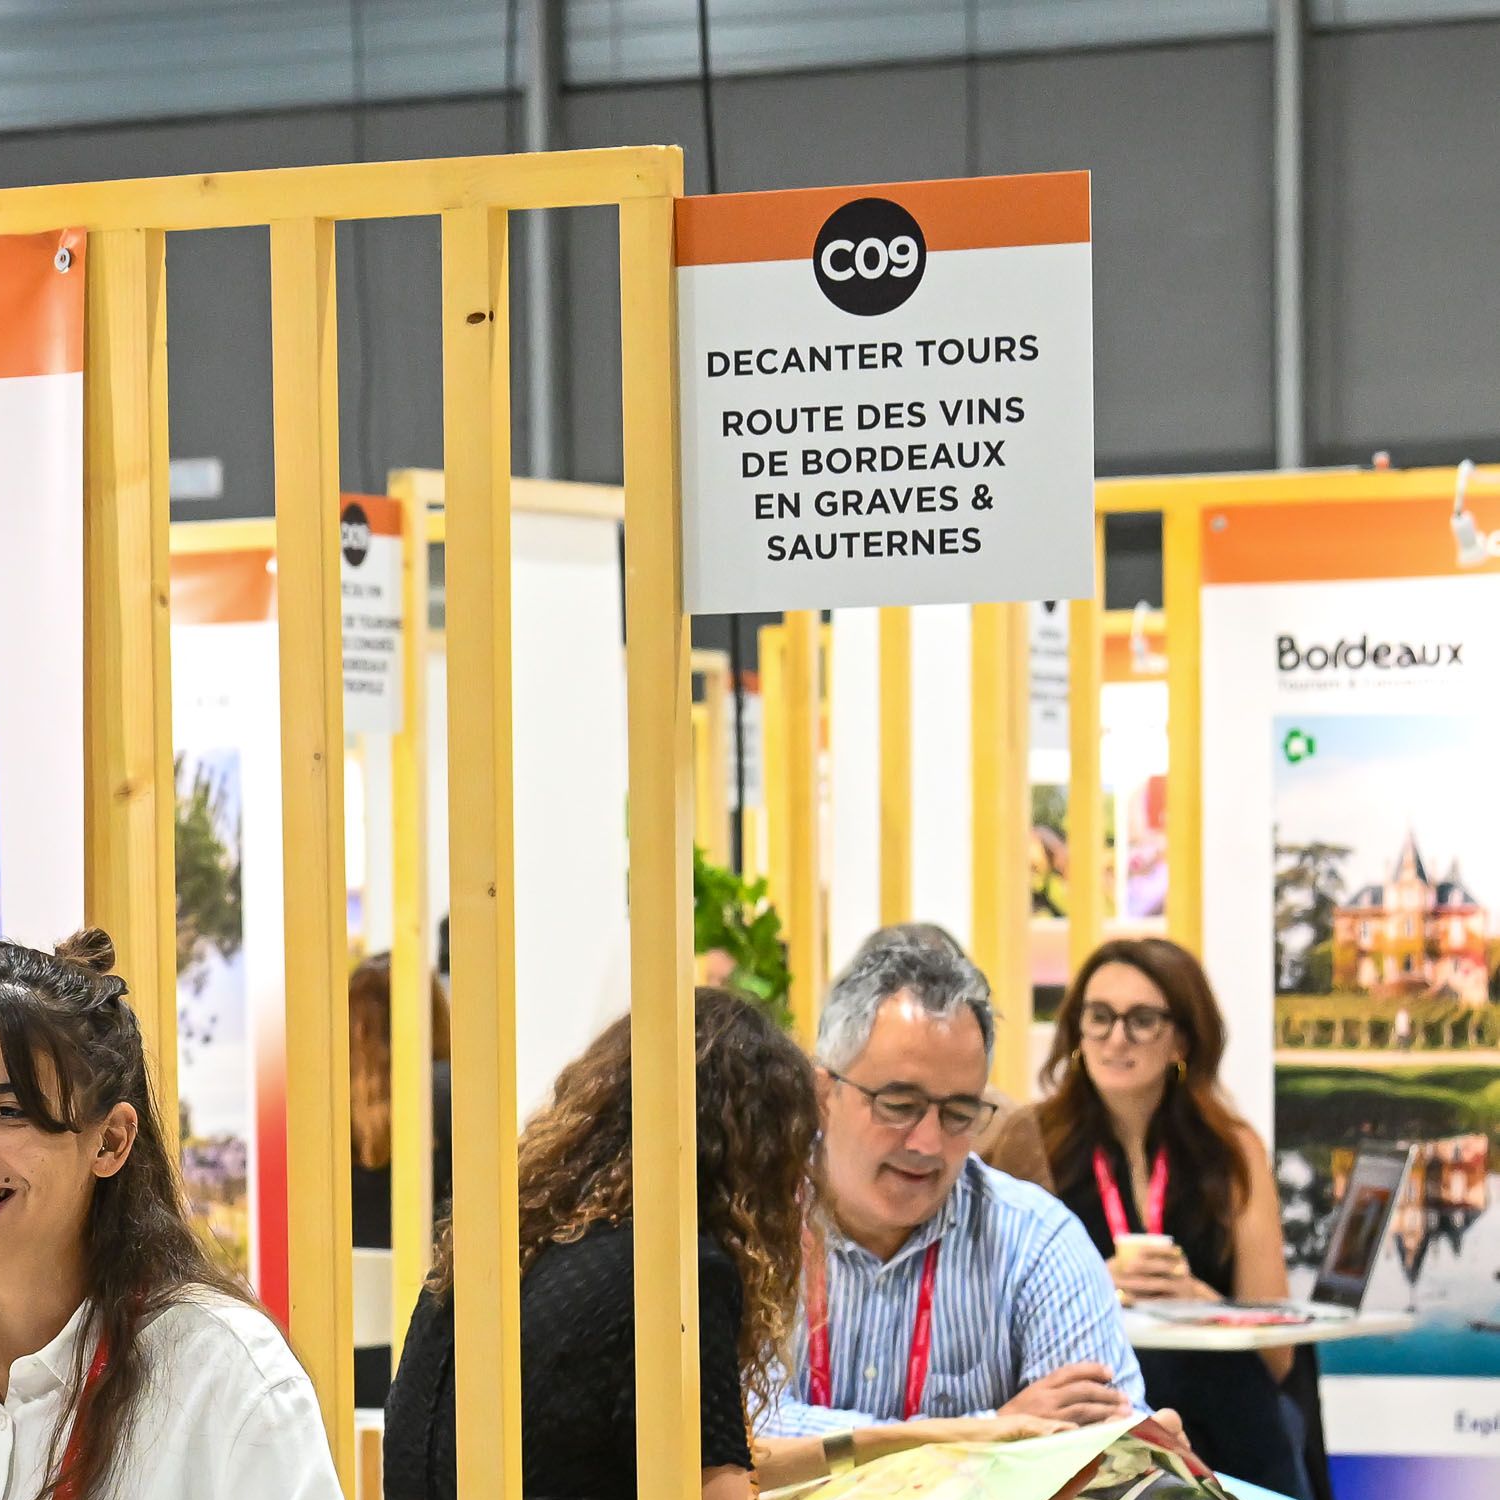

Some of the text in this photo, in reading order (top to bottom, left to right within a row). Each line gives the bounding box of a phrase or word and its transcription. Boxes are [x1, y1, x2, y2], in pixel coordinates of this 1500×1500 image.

[820, 235, 919, 282] C09
[707, 334, 1040, 378] DECANTER TOURS
[722, 396, 1025, 437] ROUTE DES VINS
[742, 440, 1006, 478] DE BORDEAUX
[754, 483, 994, 520] EN GRAVES &
[767, 526, 982, 562] SAUTERNES
[1277, 633, 1463, 671] Bordeaux
